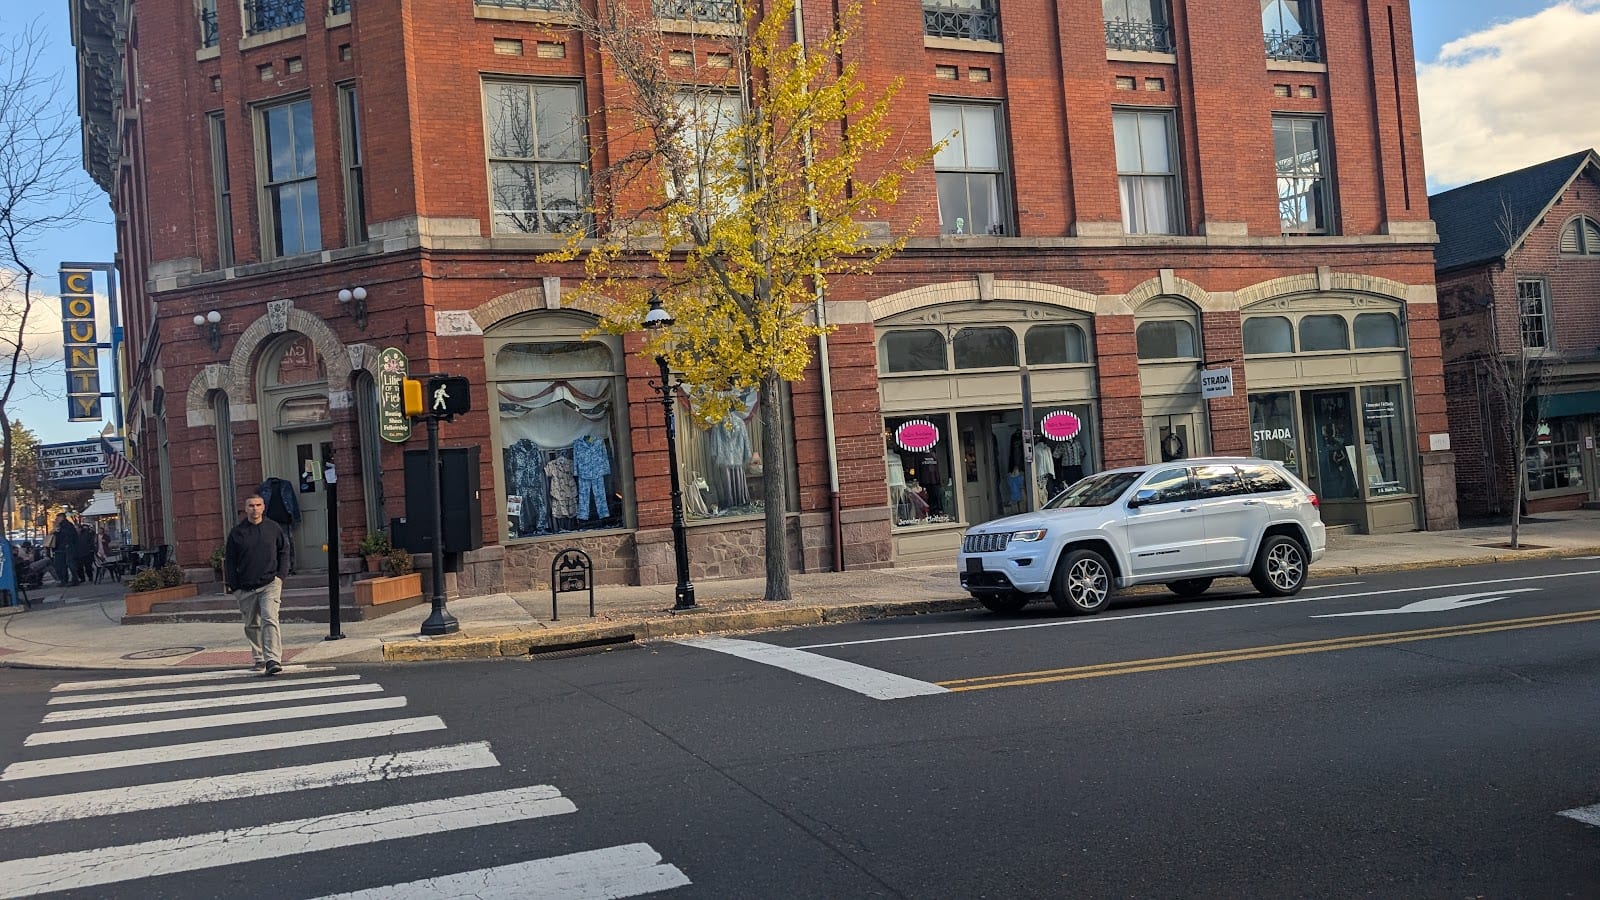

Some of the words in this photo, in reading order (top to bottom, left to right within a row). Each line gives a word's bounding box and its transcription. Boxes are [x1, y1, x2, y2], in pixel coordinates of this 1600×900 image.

[66, 273, 97, 417] COUNTY
[1203, 375, 1230, 386] STRADA
[1253, 428, 1292, 442] STRADA
[42, 447, 74, 456] NOUVELLE
[76, 444, 97, 453] VAGUE
[58, 456, 99, 466] MASTERMIND
[898, 516, 920, 526] Jewelry
